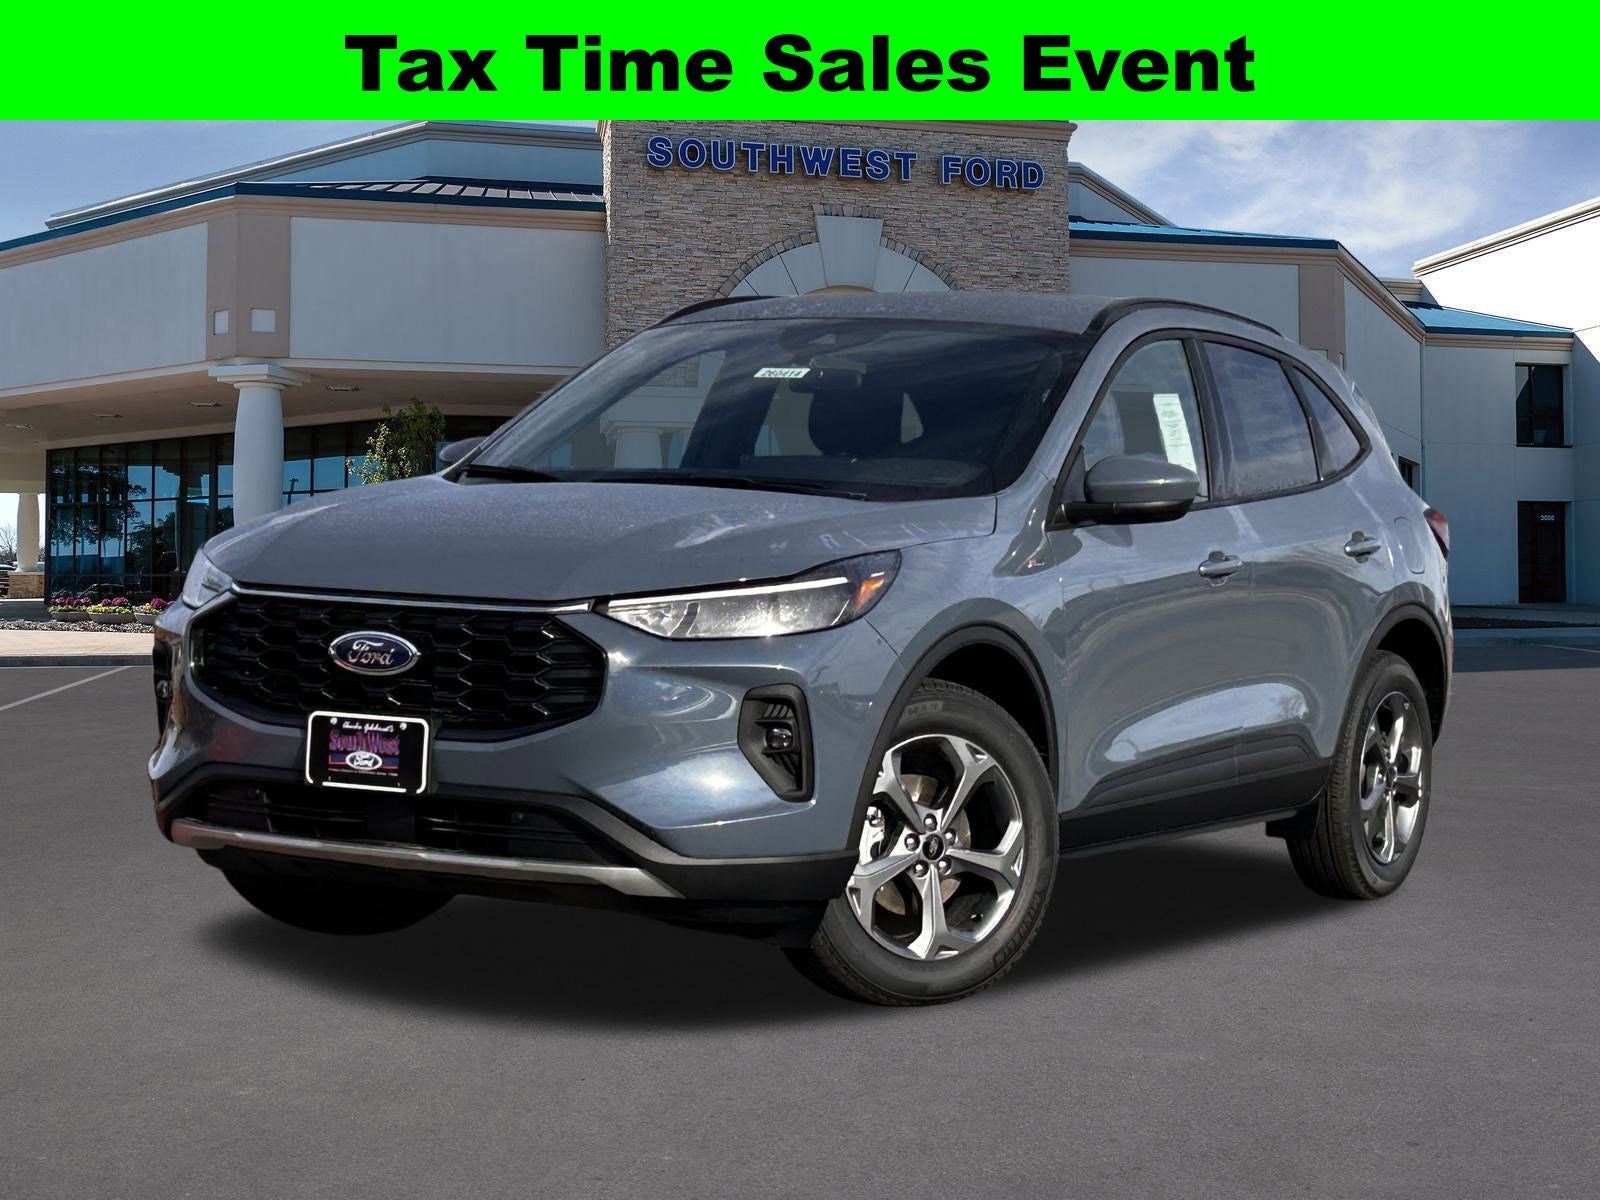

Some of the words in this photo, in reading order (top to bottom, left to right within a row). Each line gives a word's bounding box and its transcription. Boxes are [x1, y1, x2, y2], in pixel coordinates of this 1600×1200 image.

[646, 135, 918, 182] SOUTHWEST
[941, 154, 1046, 191] FORD
[348, 639, 396, 666] Ford
